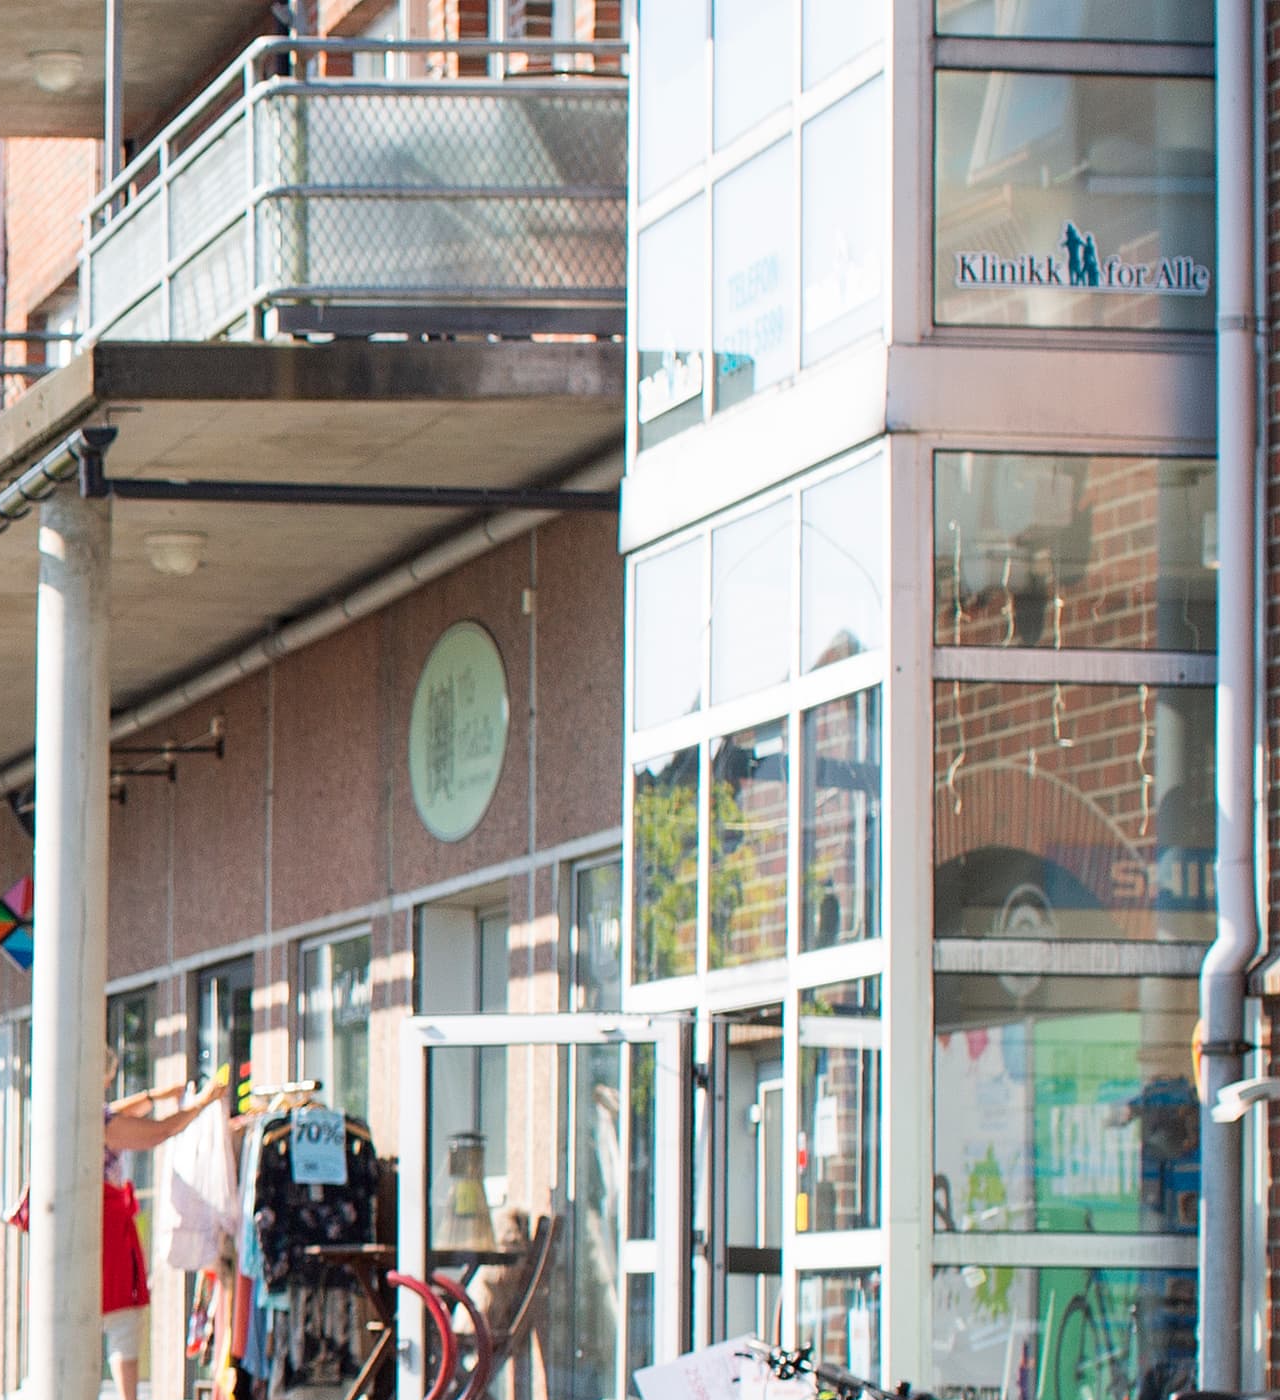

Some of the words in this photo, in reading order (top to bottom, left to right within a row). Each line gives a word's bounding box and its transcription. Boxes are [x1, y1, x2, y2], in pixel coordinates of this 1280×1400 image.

[959, 255, 1062, 285] Klinikk
[1106, 256, 1145, 286] for
[1156, 258, 1209, 290] Alle
[295, 1119, 345, 1146] 70%
